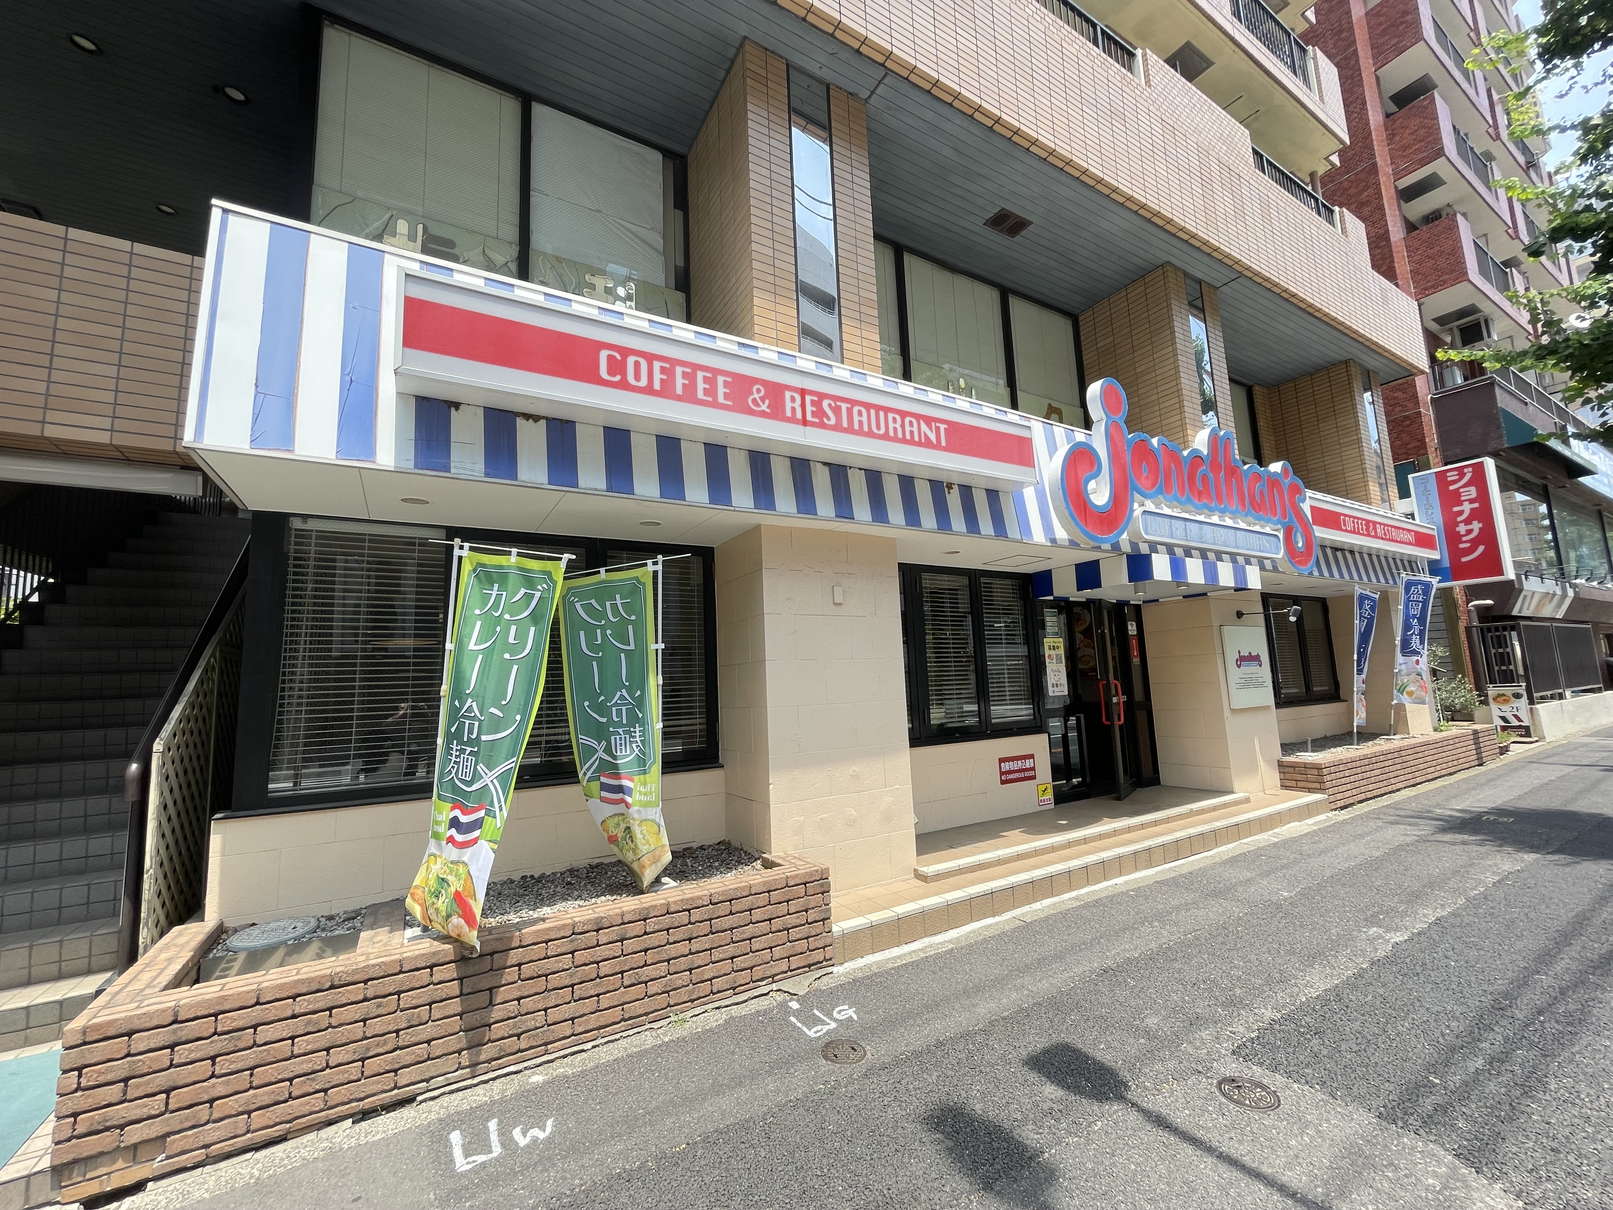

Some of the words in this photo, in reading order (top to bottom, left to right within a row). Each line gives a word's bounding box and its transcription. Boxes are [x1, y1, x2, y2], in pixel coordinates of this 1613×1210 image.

[599, 349, 733, 406] COFFEE
[748, 384, 771, 413] &
[785, 390, 949, 447] RESTAURANT
[1340, 515, 1368, 536] COFFEE
[1376, 524, 1416, 544] RESTAURANT
[1446, 467, 1486, 563] ジョナサン
[442, 583, 507, 786] カレー冷麺
[480, 583, 549, 742] グリーン
